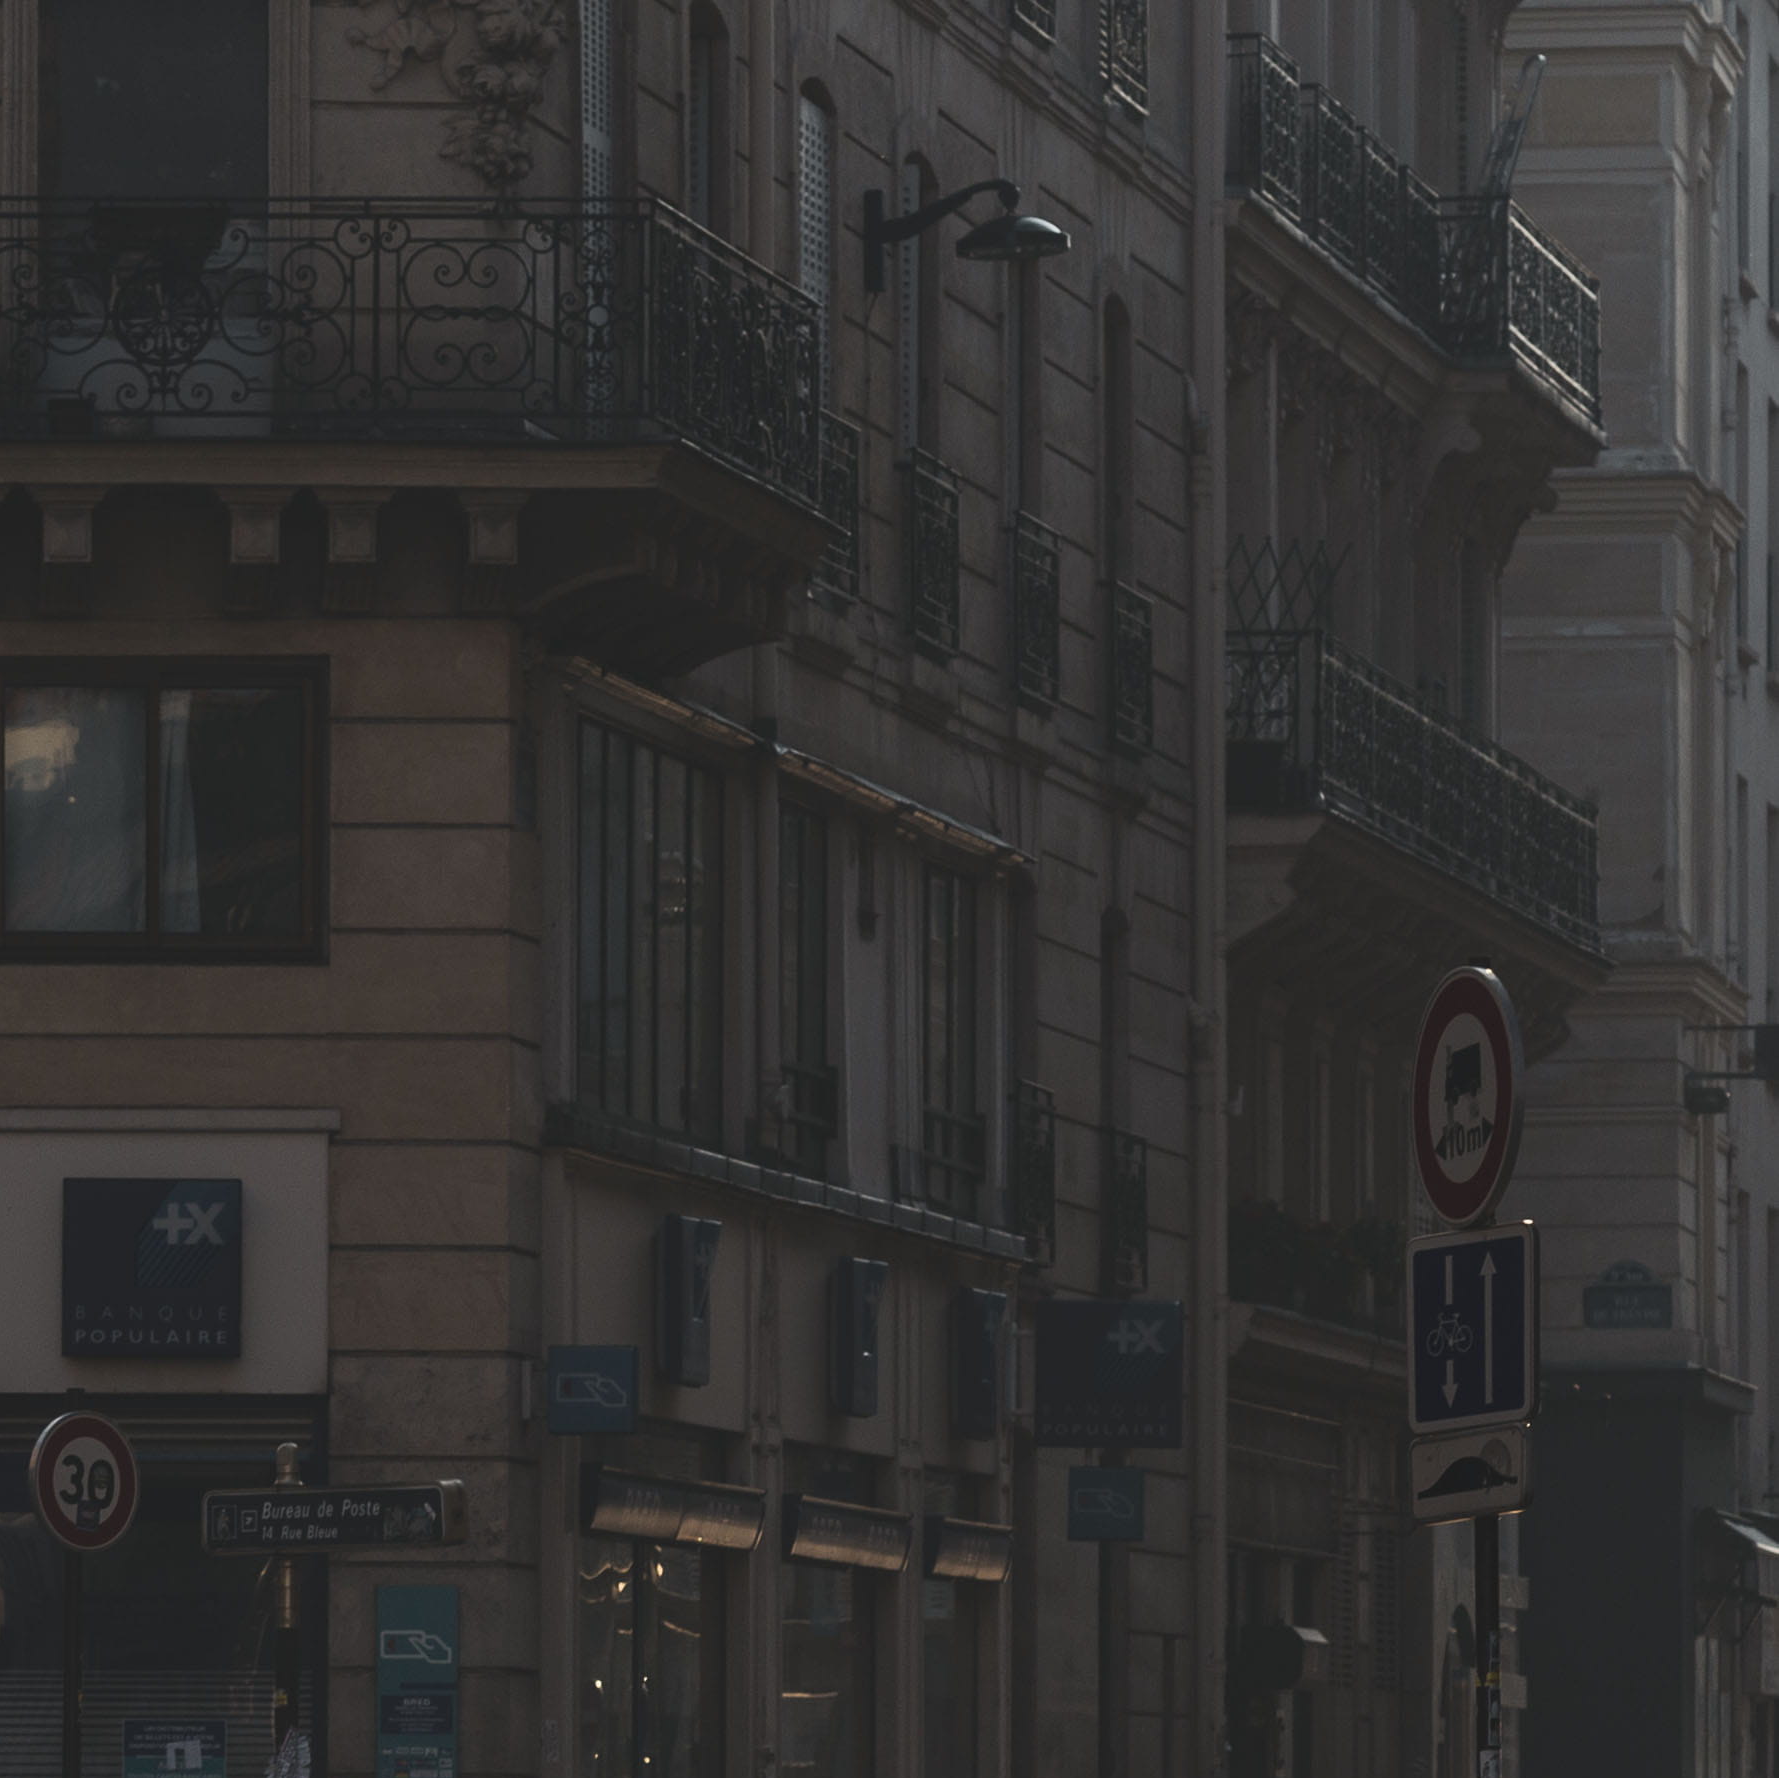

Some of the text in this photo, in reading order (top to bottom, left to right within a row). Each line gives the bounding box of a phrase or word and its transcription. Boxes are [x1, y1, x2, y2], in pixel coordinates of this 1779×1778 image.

[74, 1304, 229, 1324] BANQUE
[74, 1328, 228, 1345] POPULAIRE
[1041, 1423, 1168, 1437] POPULAIRE
[59, 1454, 115, 1510] 30
[261, 1498, 381, 1520] Bureau de Poste
[261, 1524, 339, 1541] 14 Rue Bleue
